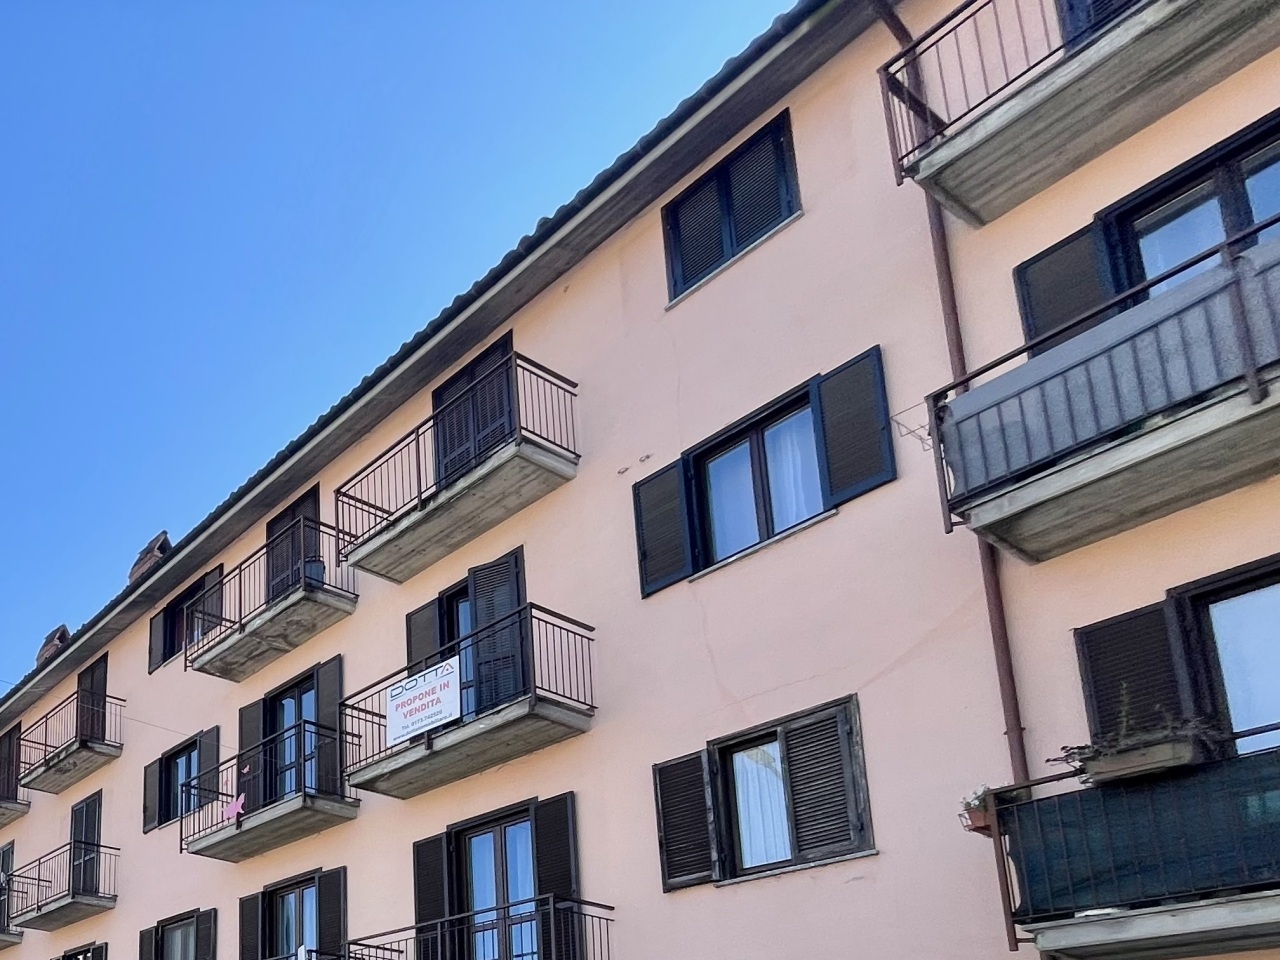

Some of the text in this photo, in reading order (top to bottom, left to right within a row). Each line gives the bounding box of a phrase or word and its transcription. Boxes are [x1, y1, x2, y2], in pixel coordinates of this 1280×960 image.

[390, 662, 454, 699] DOTTA
[395, 680, 450, 712] PROPONE IN
[403, 696, 442, 720] VENDITA
